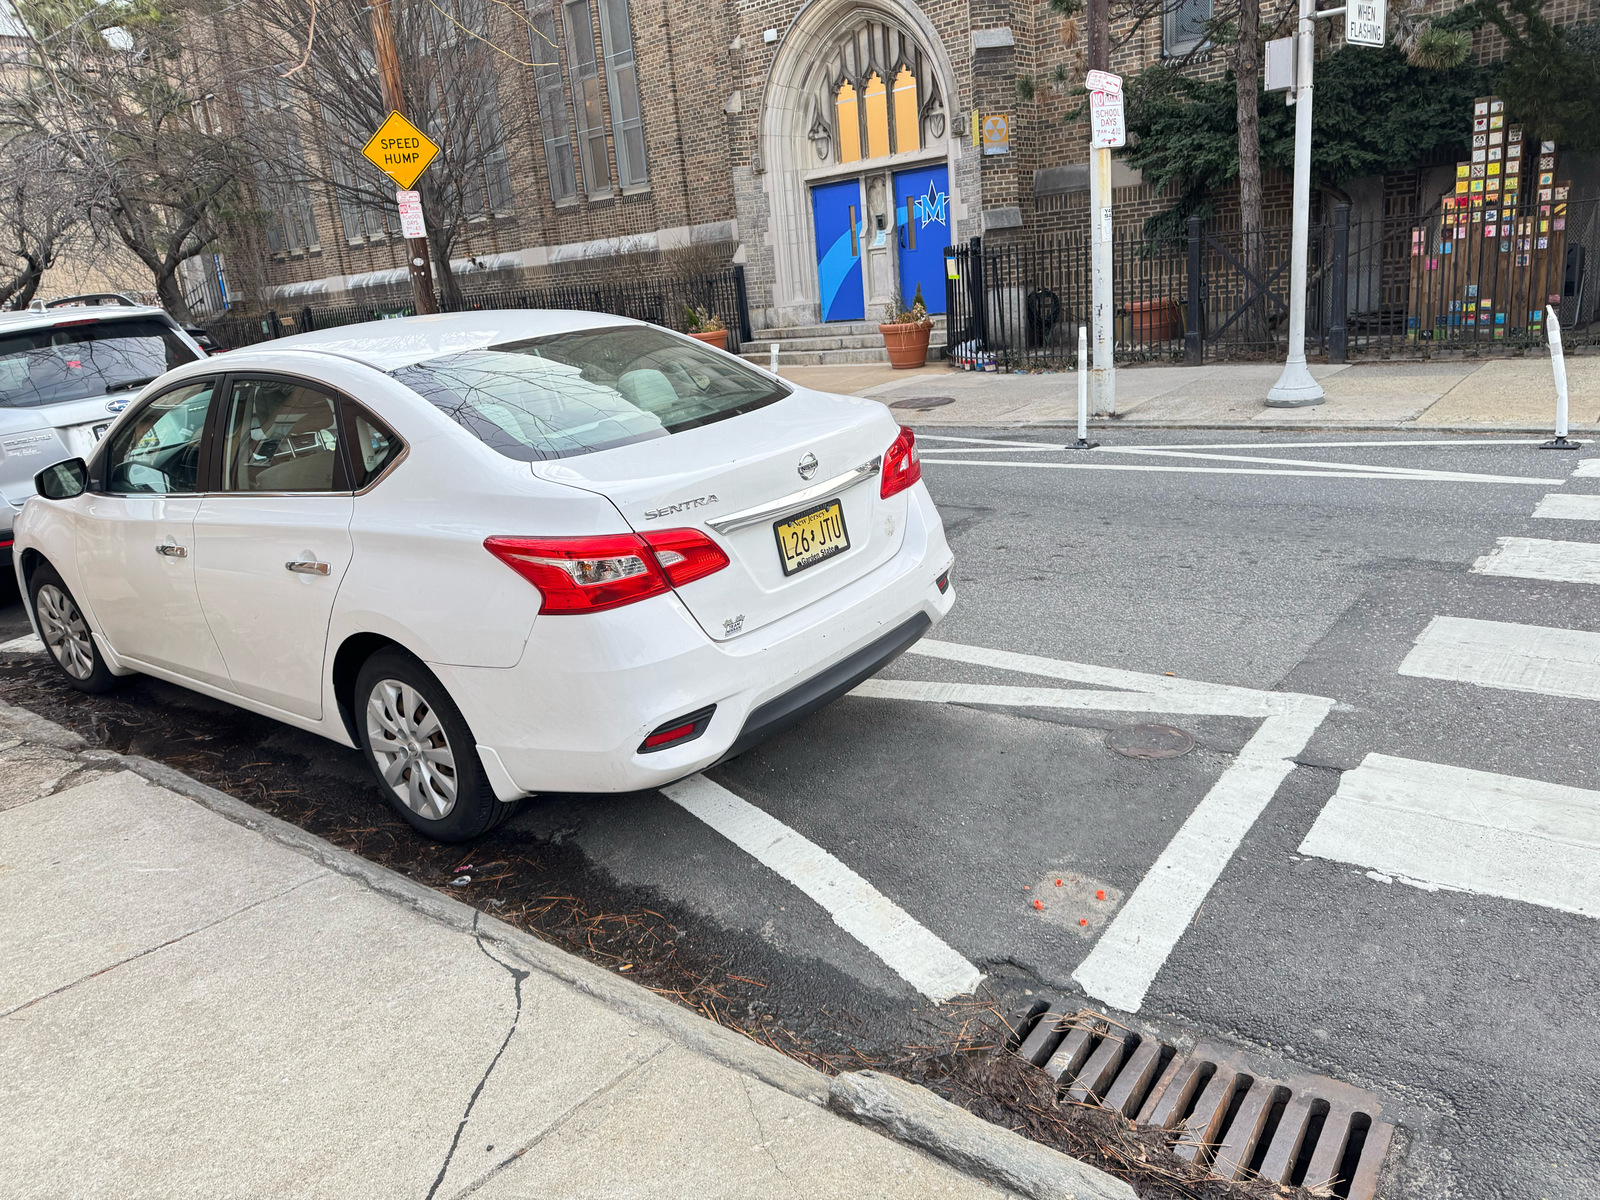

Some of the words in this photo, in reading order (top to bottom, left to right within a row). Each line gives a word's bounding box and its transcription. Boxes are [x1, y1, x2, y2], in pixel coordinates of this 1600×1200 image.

[1357, 4, 1376, 22] WHEN
[1350, 22, 1381, 40] FLASHING
[1093, 93, 1103, 105] NO
[1096, 108, 1121, 118] SCHOOL
[1100, 118, 1117, 127] DAYS
[380, 138, 420, 150] SPEED
[384, 153, 420, 164] HUMP
[921, 192, 945, 222] M
[800, 461, 816, 472] NISSAN
[644, 494, 719, 520] SENTRA
[792, 517, 807, 528] New
[807, 511, 825, 524] Jersey
[800, 552, 820, 565] Garden
[820, 546, 836, 557] State
